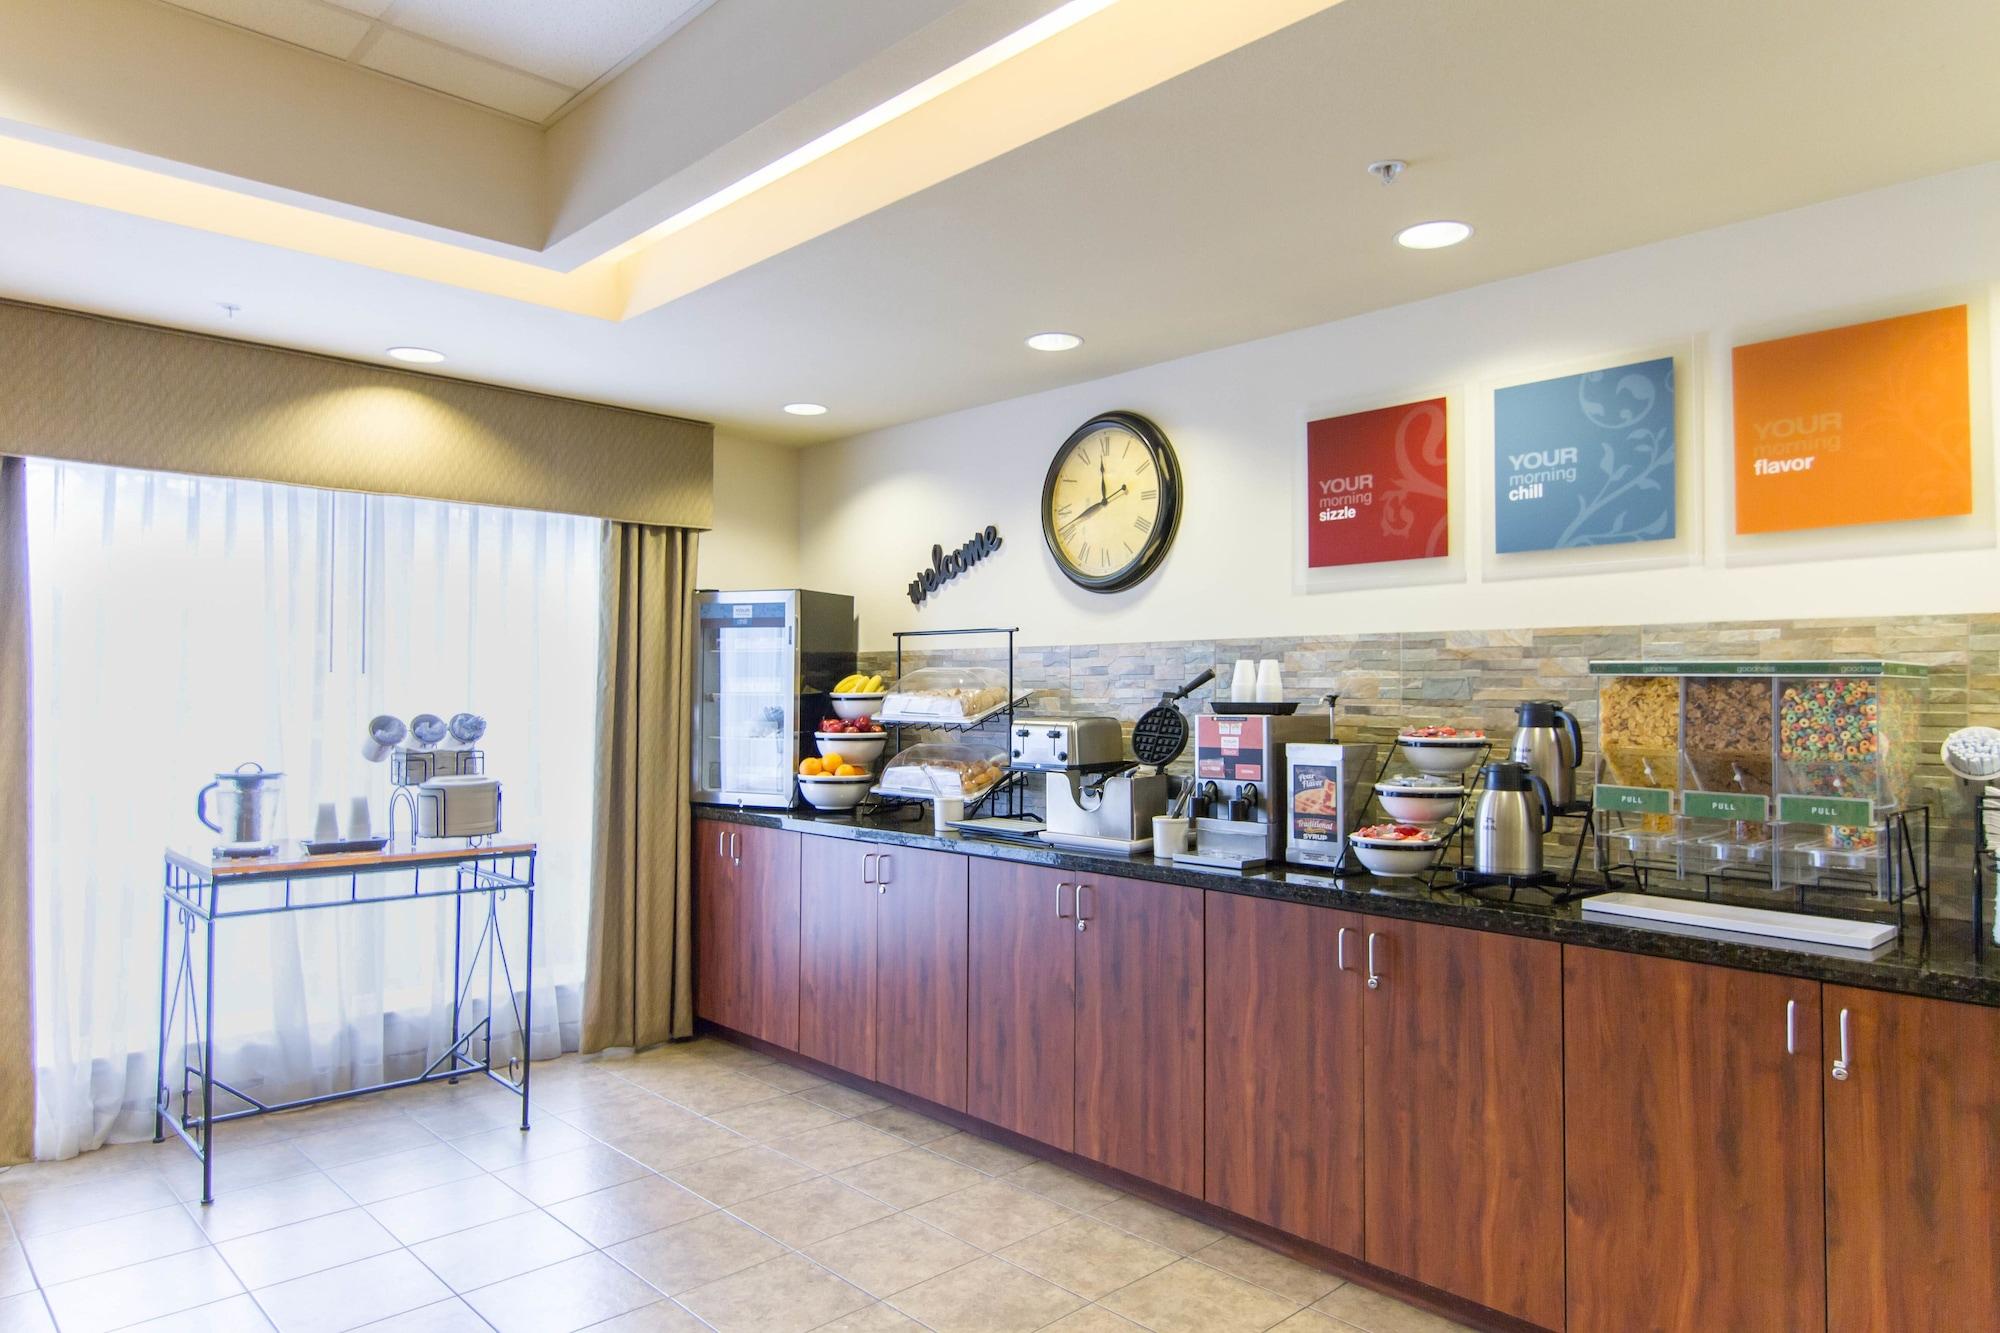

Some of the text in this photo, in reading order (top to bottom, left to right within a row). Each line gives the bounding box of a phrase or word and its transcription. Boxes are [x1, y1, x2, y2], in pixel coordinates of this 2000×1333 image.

[1753, 412, 1842, 441] YOUR
[1753, 435, 1841, 459] morning
[1508, 447, 1578, 471] YOUR
[1753, 456, 1815, 476] flavor
[1319, 474, 1373, 495] YOUR
[1509, 467, 1577, 487] morning
[1319, 491, 1372, 508] morning
[1508, 483, 1543, 501] chill
[1319, 505, 1356, 522] sizzle
[906, 525, 1003, 605] welcome
[1736, 665, 1776, 674] goodness
[1620, 795, 1643, 805] PULL
[1711, 802, 1737, 811] PULL
[1810, 806, 1839, 817] PULL
